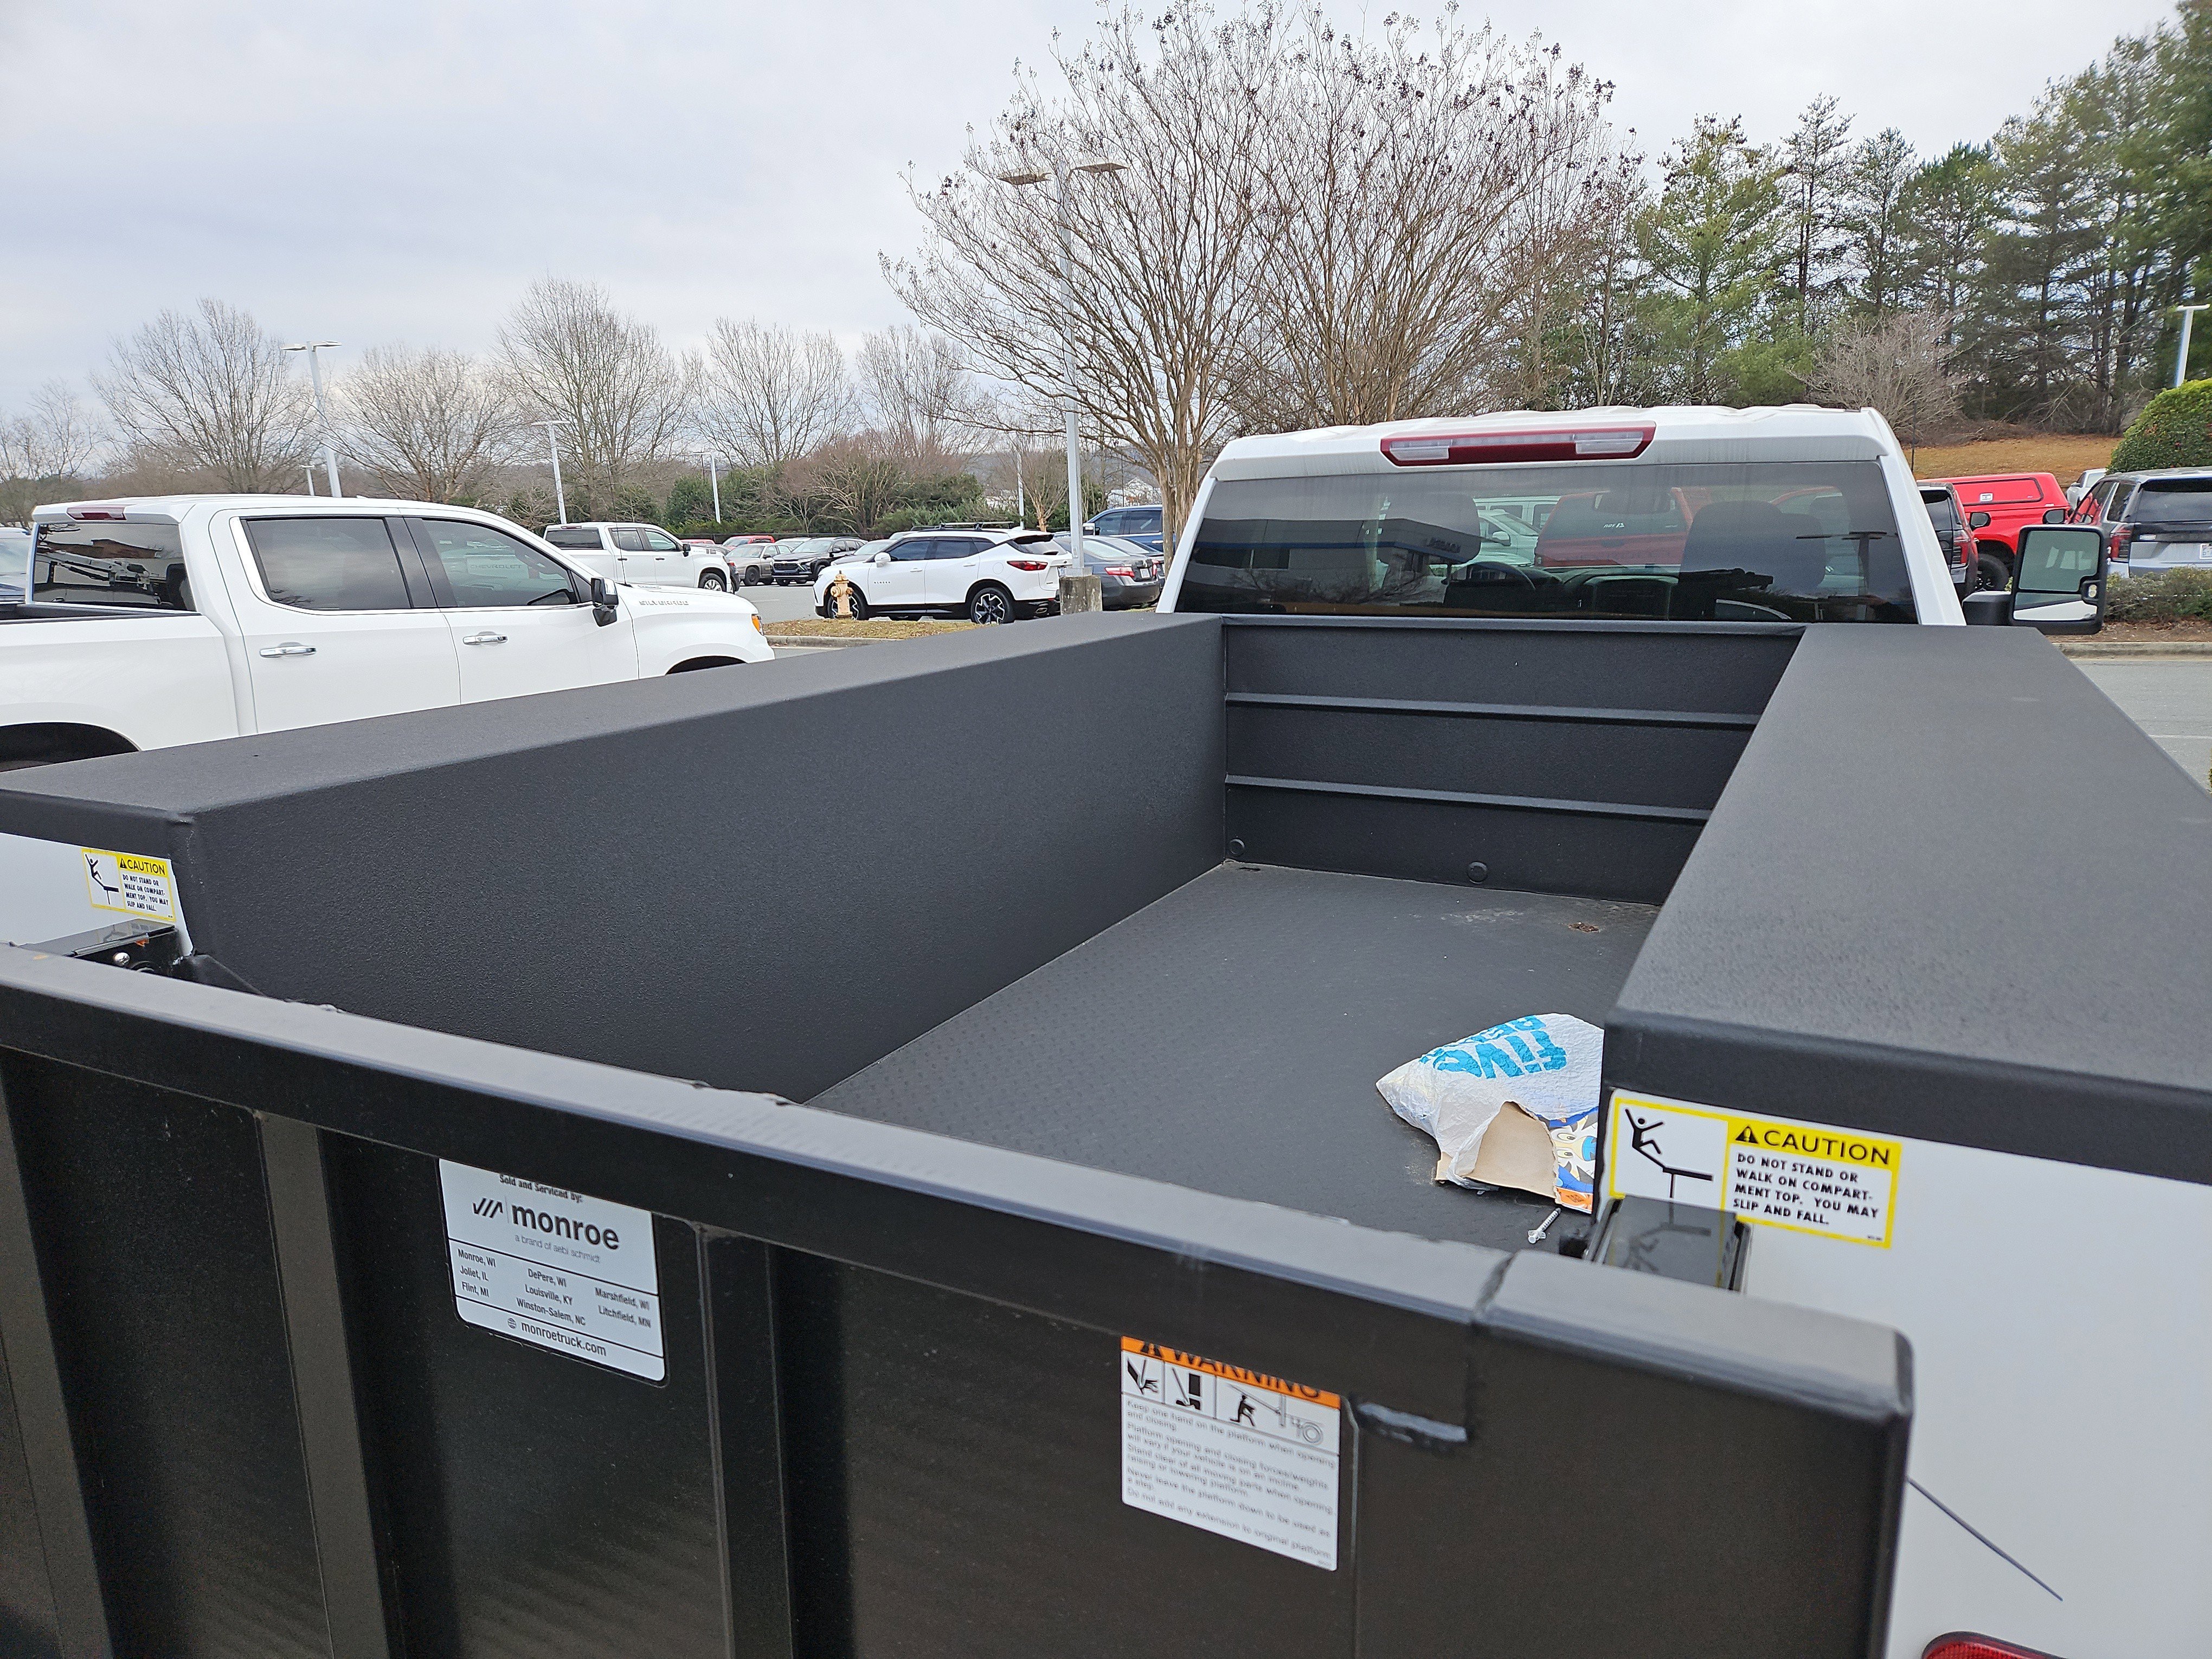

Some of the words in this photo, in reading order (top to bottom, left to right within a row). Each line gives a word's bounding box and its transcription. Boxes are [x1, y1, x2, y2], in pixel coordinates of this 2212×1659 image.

[127, 859, 165, 875] CAUTION
[1764, 1130, 1889, 1165] CAUTION
[1737, 1153, 1755, 1164] DO
[1761, 1158, 1786, 1170] NOT
[1791, 1163, 1833, 1178] STAND
[1840, 1171, 1858, 1183] OR
[1737, 1168, 1772, 1184] WALK
[1778, 1176, 1797, 1187] ON
[499, 1173, 517, 1186] Sold
[518, 1180, 533, 1191] and
[534, 1182, 568, 1199] Serviced
[1733, 1198, 1759, 1211] SLIP
[1764, 1204, 1791, 1217] AND
[1797, 1210, 1829, 1225] FALL.
[1734, 1184, 1770, 1198] MENT
[1776, 1190, 1803, 1204] TOP.
[1814, 1198, 1841, 1211] YOU
[1847, 1204, 1878, 1218] MAY
[511, 1205, 619, 1250] monroe
[521, 1235, 543, 1249] brand
[544, 1242, 551, 1250] of
[458, 1248, 486, 1266] Monroe,
[486, 1256, 496, 1268] WI
[460, 1265, 481, 1281] Joliet,
[481, 1271, 489, 1282] IL
[528, 1268, 556, 1286] DePere,
[556, 1276, 567, 1288] WI
[461, 1281, 479, 1296] Flint,
[480, 1287, 489, 1297] MI
[525, 1284, 562, 1304] Louisville,
[563, 1295, 573, 1306] KY
[595, 1287, 638, 1308] Marshfield,
[639, 1300, 650, 1310] WI
[516, 1297, 574, 1324] Winston-Salem,
[575, 1315, 586, 1326] NC
[598, 1305, 636, 1325] Litchfield,
[638, 1316, 651, 1328] MN
[520, 1322, 607, 1356] monroetruck.com
